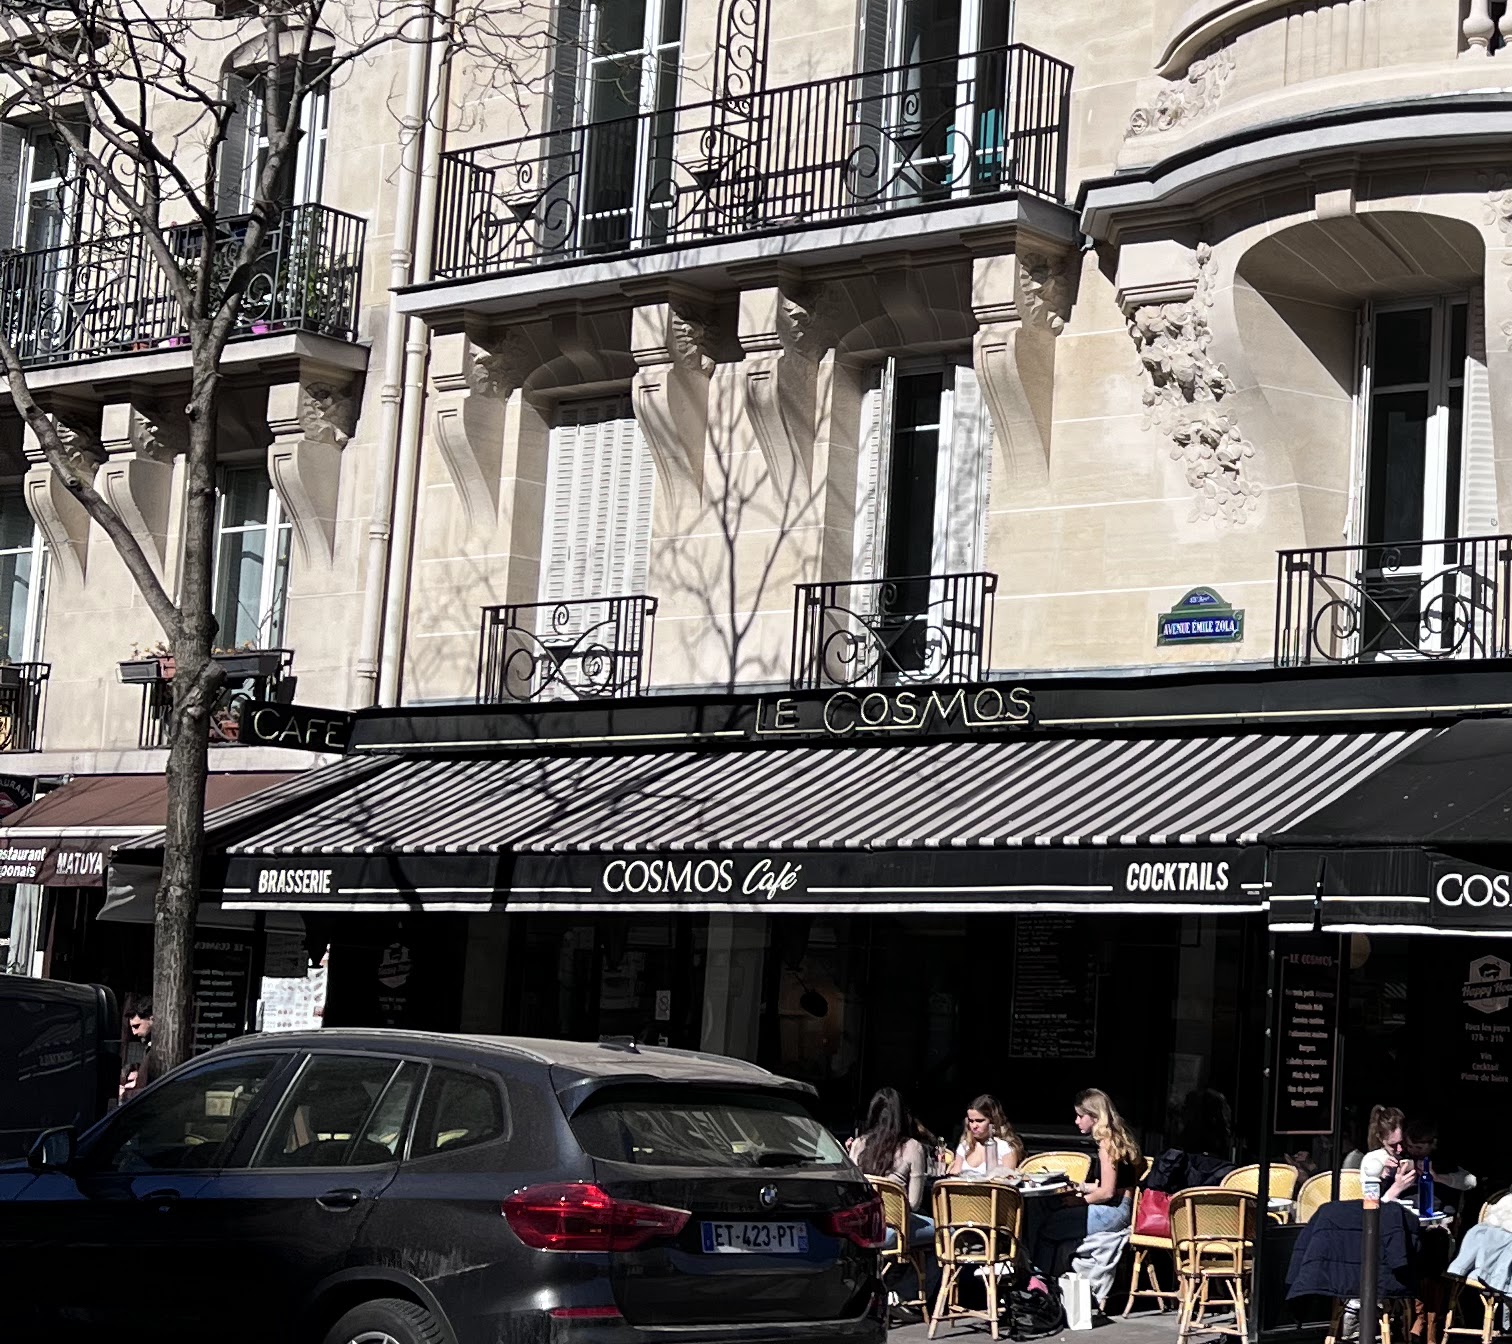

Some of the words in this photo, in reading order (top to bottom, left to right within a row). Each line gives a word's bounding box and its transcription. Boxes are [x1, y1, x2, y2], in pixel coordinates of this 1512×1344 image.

[1163, 622, 1191, 636] AVENUE
[1216, 619, 1236, 633] ZOLA
[755, 697, 798, 734] LE
[823, 687, 1031, 735] COSMOS
[56, 852, 104, 875] MATUYA
[1125, 861, 1230, 892] COCKTAILS
[257, 869, 333, 894] BRASSERIE
[602, 859, 734, 894] COSMOS
[742, 858, 803, 901] Café
